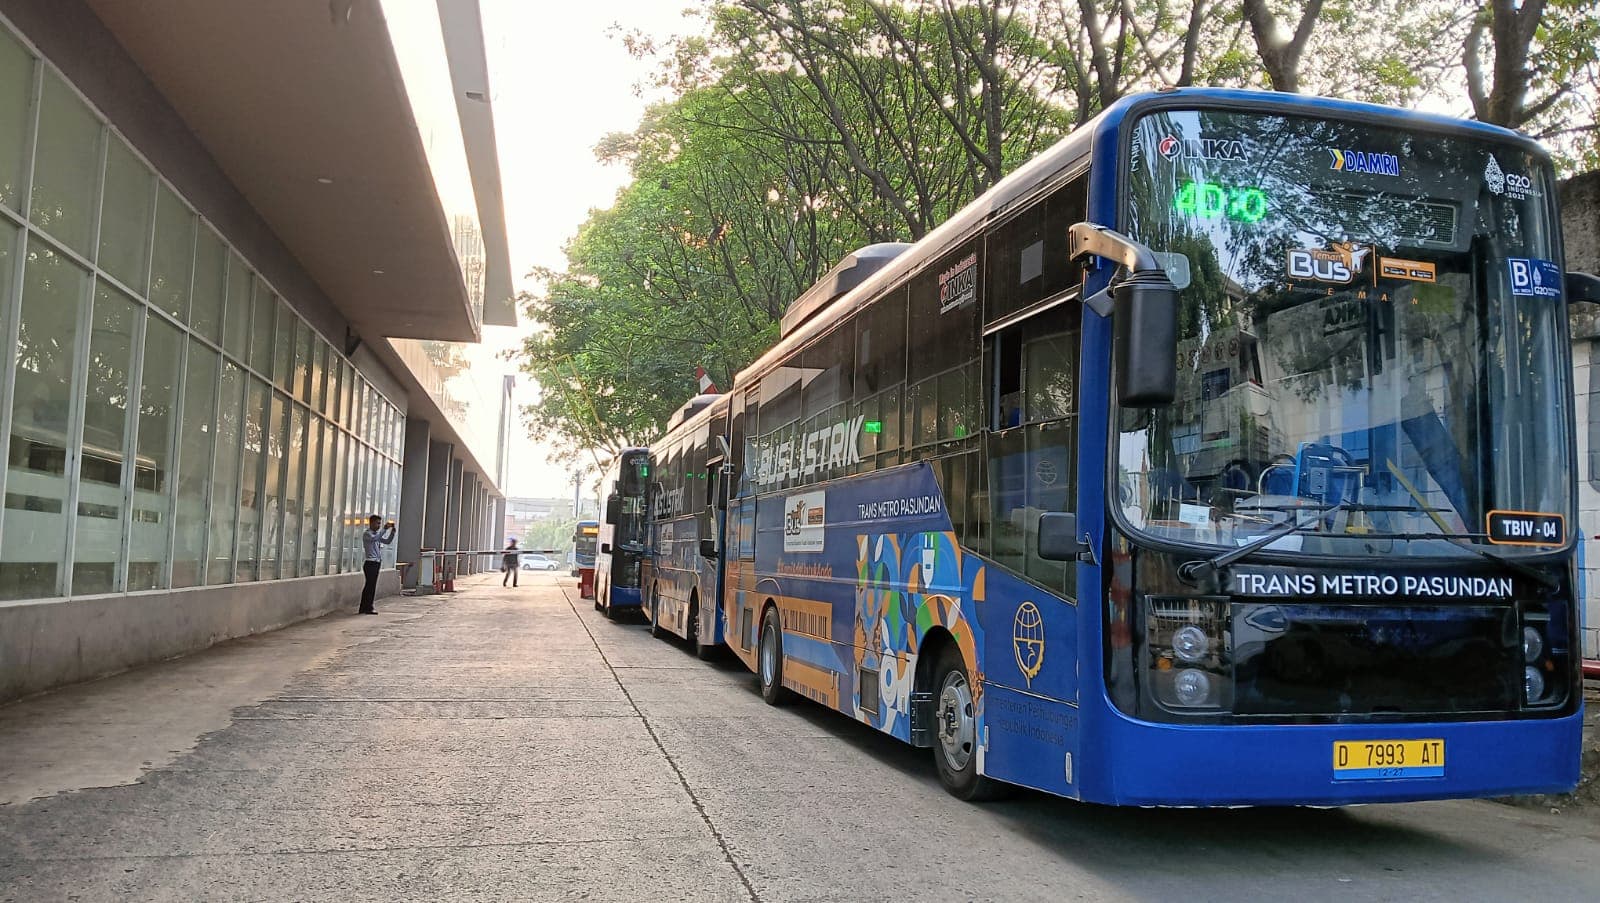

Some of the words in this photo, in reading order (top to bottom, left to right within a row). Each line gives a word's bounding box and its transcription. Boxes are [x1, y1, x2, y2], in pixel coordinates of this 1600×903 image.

[1183, 138, 1249, 161] INKA
[1343, 149, 1400, 176] DAMRI
[1506, 173, 1531, 188] G20
[1507, 185, 1543, 198] INDONESIA
[1312, 250, 1342, 261] Teman
[1512, 261, 1530, 287] B
[788, 414, 865, 479] LISTRIK
[858, 502, 877, 520] TRANS
[878, 500, 900, 517] METRO
[900, 494, 941, 515] PASUNDAN
[1502, 519, 1534, 537] TBIV
[1543, 521, 1556, 538] 04
[1236, 573, 1316, 595] TRANS
[1322, 575, 1399, 596] METRO
[1404, 575, 1513, 598] PASUNDAN
[1338, 745, 1349, 767] D
[1365, 744, 1405, 767] 7993
[1421, 742, 1441, 765] AT
